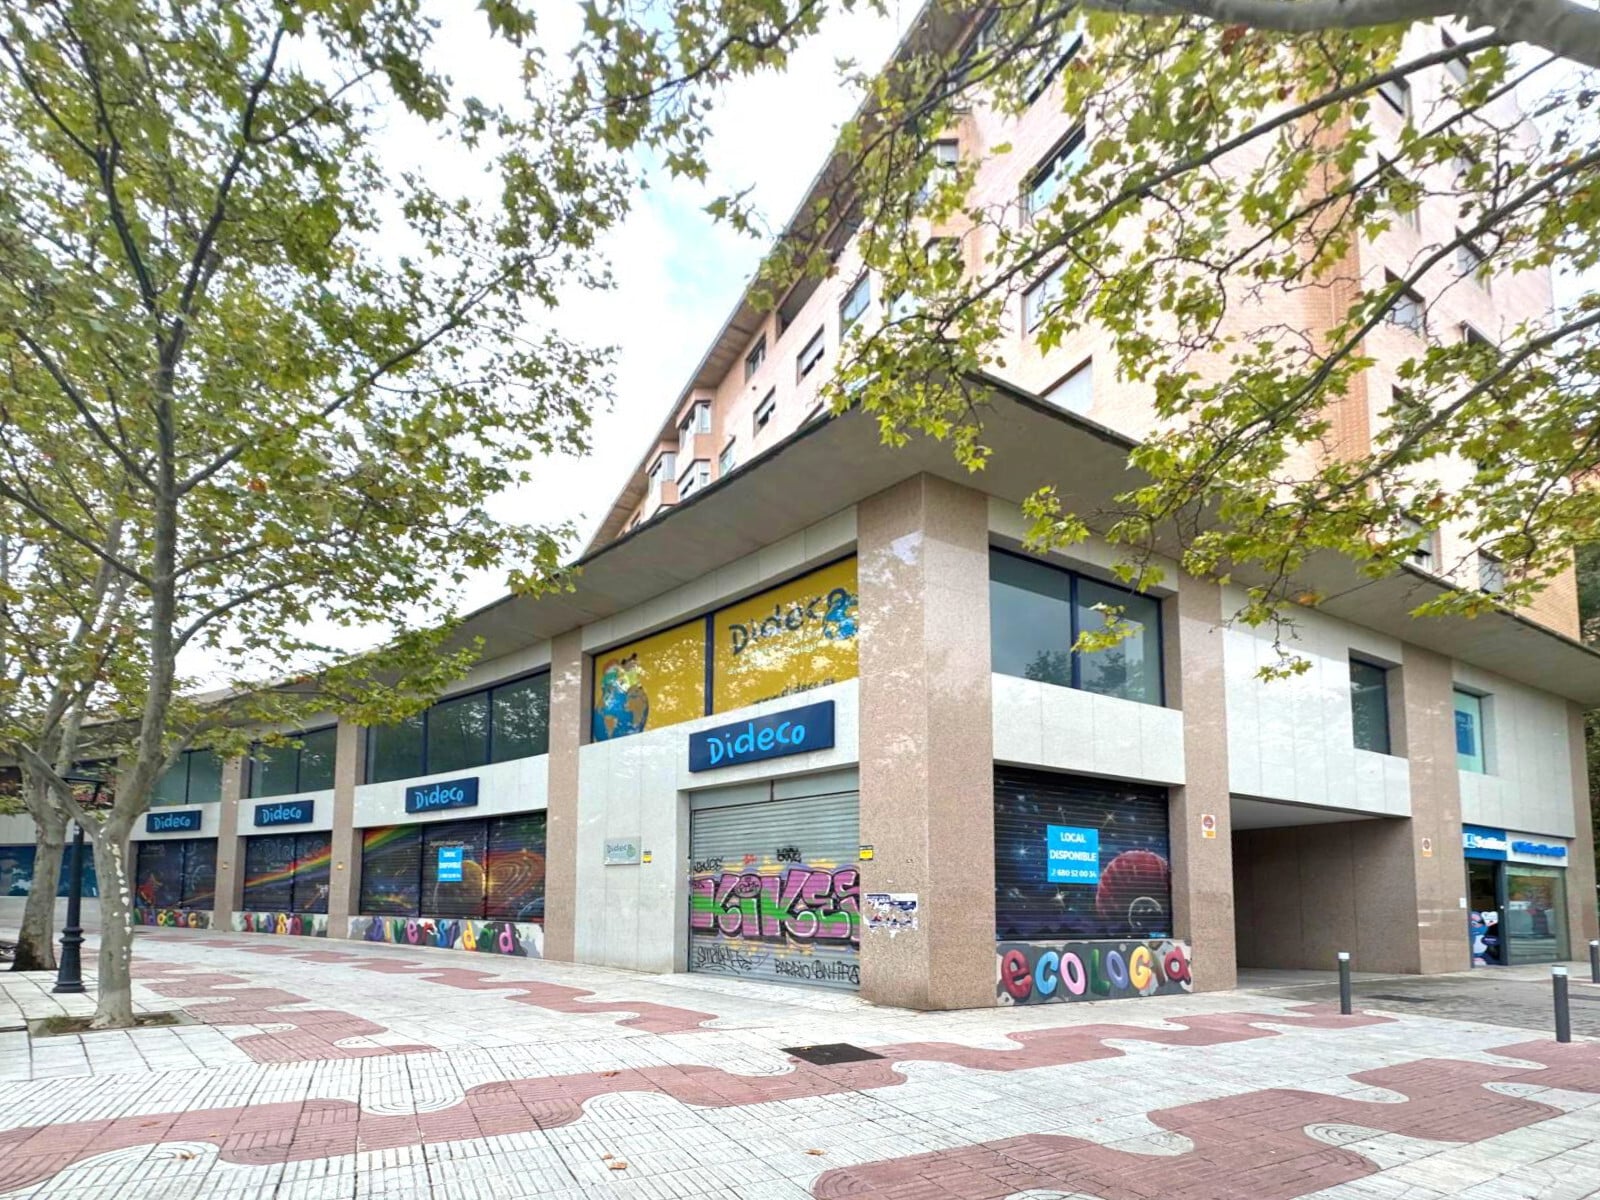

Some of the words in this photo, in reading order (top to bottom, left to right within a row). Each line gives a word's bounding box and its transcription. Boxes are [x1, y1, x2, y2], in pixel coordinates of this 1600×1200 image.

[707, 721, 806, 764] Dideco
[415, 785, 464, 809] Dideco
[154, 815, 191, 830] Dideco
[261, 806, 302, 823] Dideco
[1060, 832, 1087, 843] LOCAL
[1050, 849, 1097, 862] DISPONIBLE
